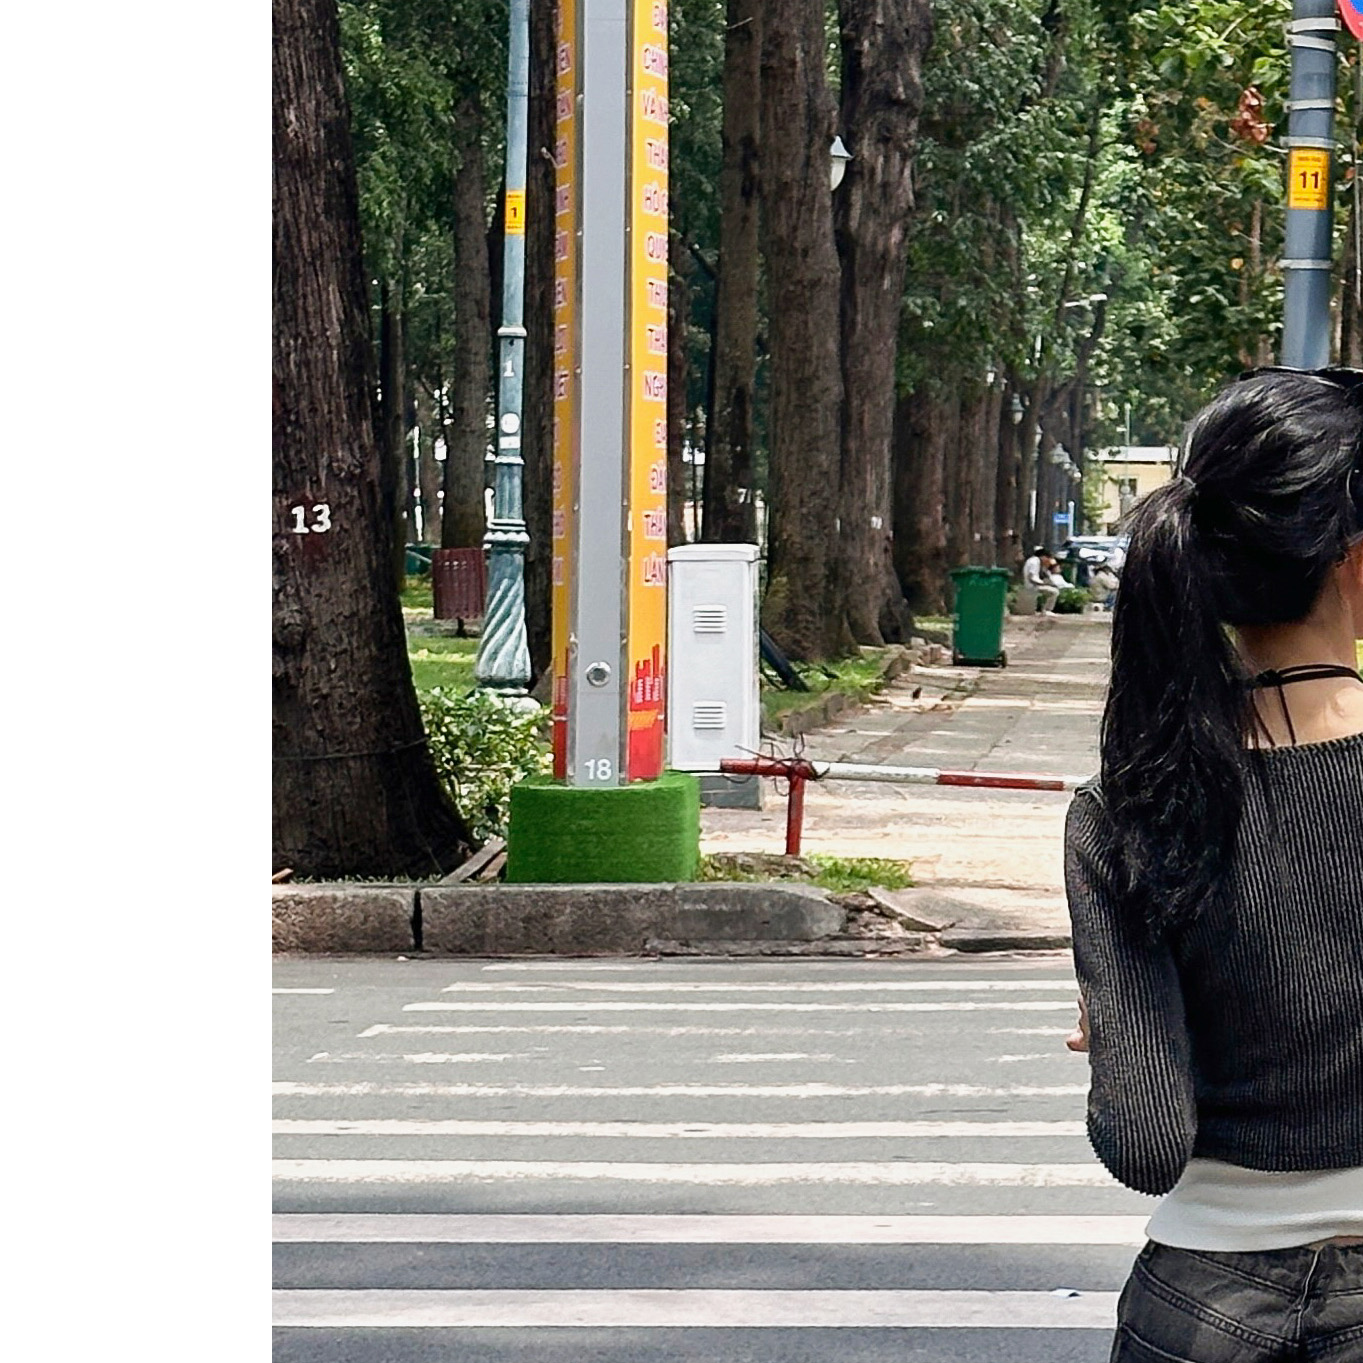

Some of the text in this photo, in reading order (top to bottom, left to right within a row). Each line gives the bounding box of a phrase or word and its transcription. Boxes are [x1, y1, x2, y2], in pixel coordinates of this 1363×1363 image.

[1299, 170, 1319, 189] 11
[510, 206, 518, 218] 1
[503, 359, 515, 377] 1
[291, 503, 332, 534] 13
[584, 758, 613, 781] 18
